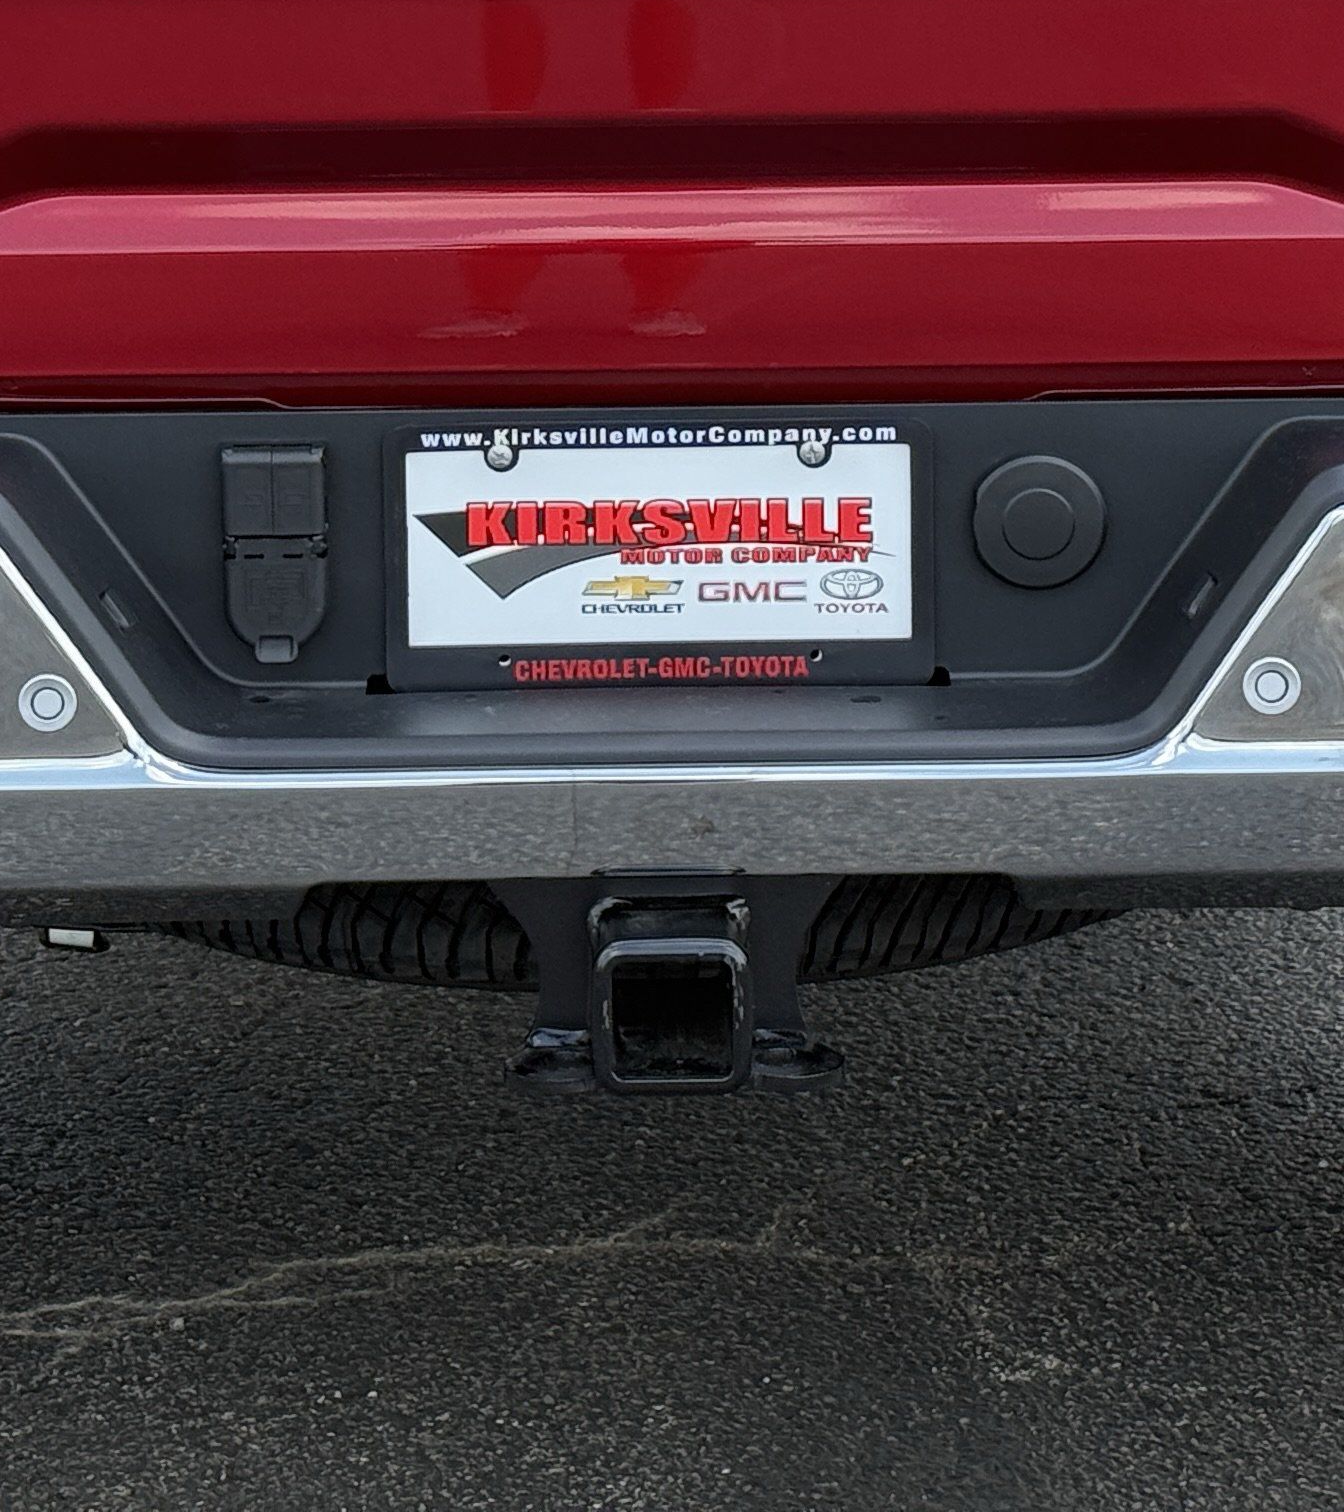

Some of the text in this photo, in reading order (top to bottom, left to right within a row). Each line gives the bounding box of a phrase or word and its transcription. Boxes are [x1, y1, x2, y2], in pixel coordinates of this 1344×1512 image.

[465, 496, 873, 547] KIRKSVILLE
[620, 545, 874, 565] MOTOR COMPANY
[697, 579, 807, 603] GMC
[581, 602, 685, 614] CHEVROLET
[814, 602, 889, 614] TOYOTA
[514, 656, 809, 683] CHEVROLET-GMC-TOYOTA
